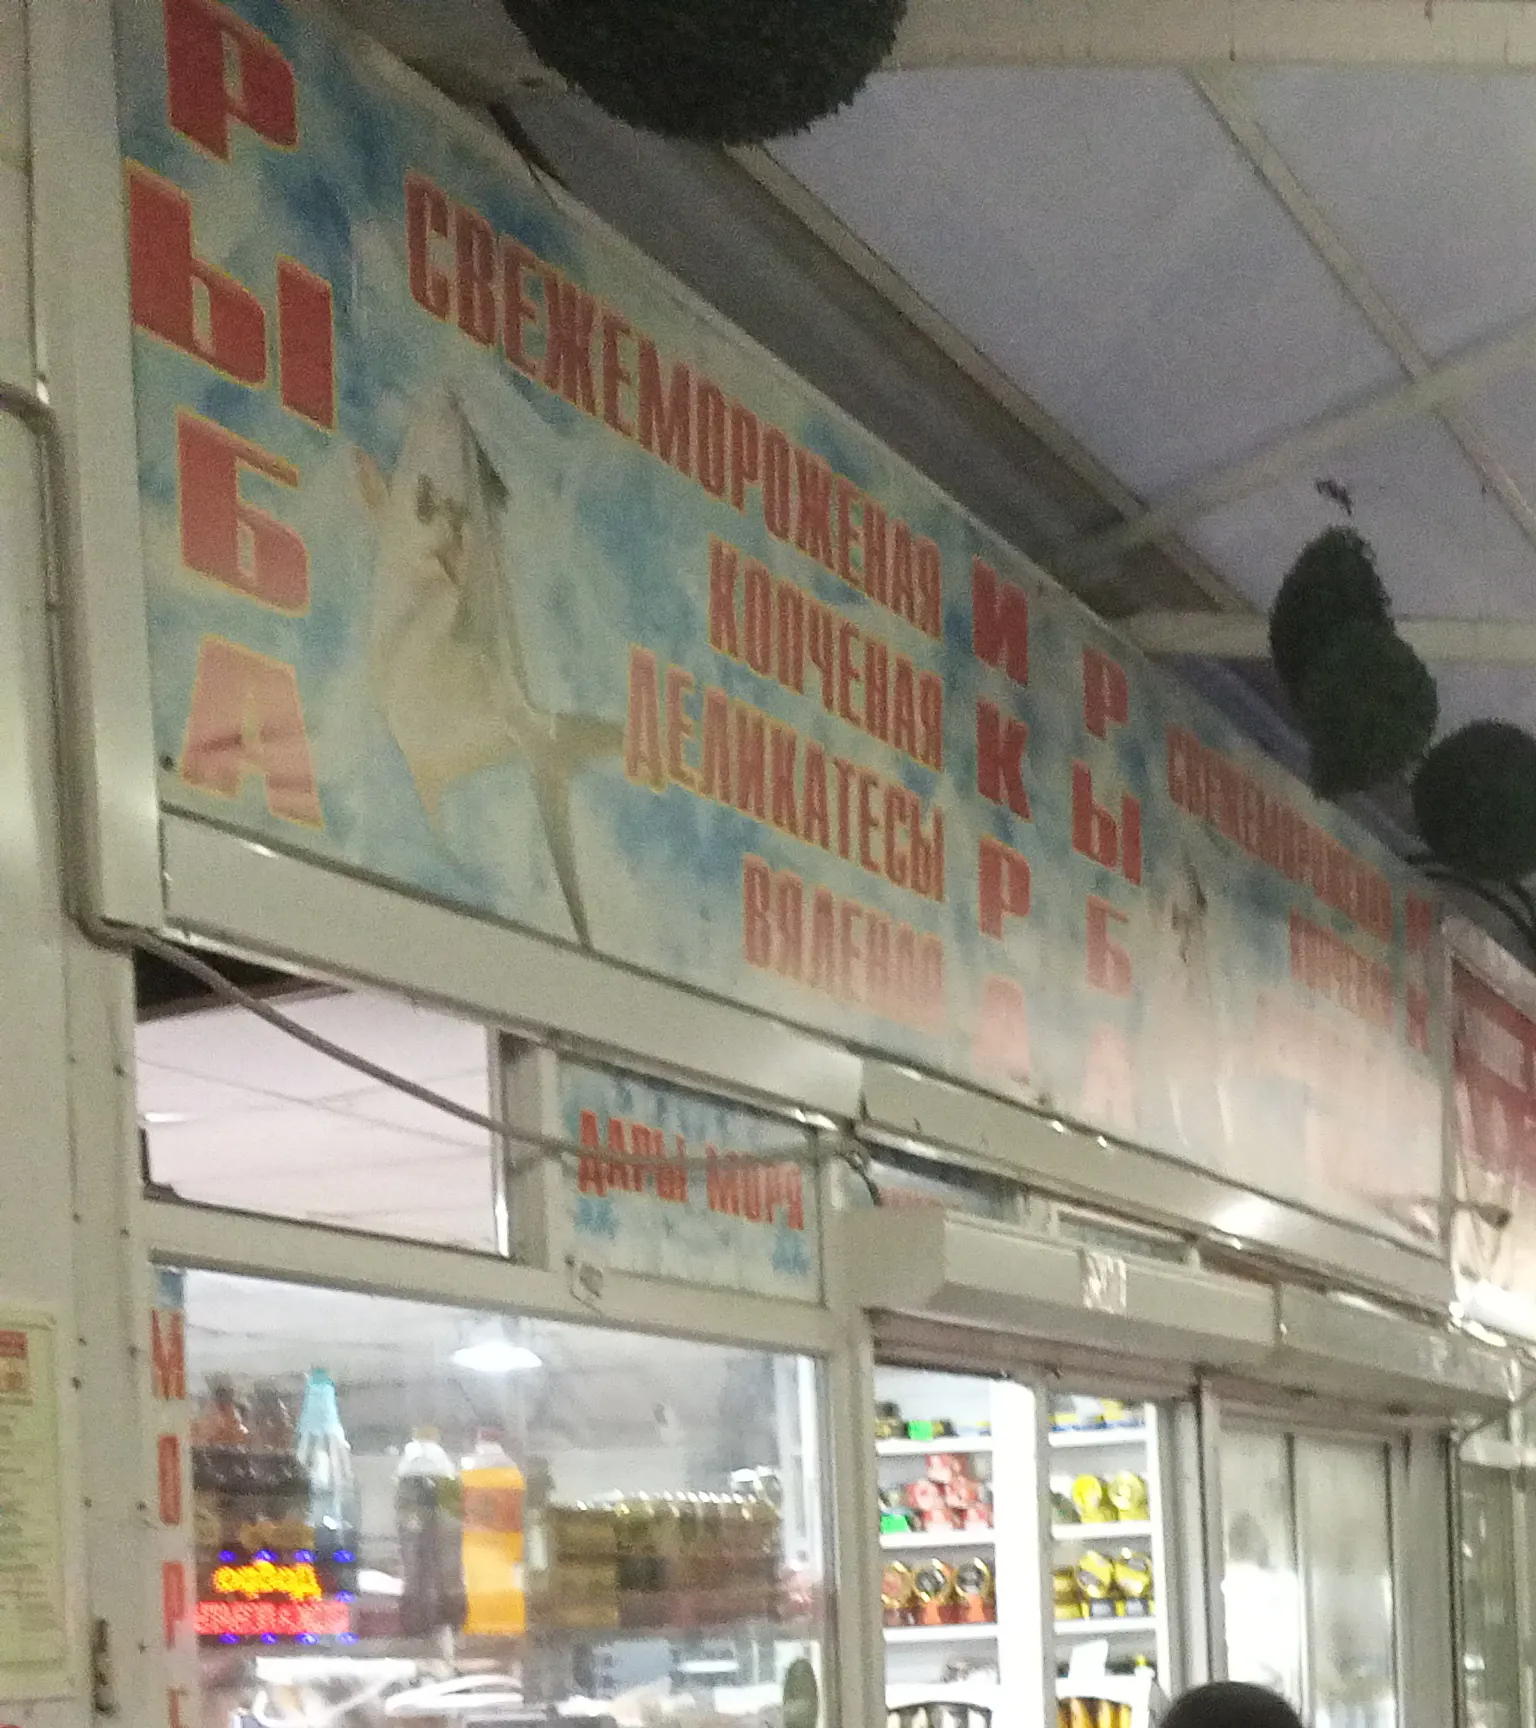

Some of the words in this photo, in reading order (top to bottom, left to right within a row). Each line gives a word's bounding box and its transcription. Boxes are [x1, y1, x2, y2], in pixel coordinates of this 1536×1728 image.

[127, 0, 335, 830] РЫБА
[405, 167, 943, 641] СВЕЖЕМОРОЖЕНАЯ
[625, 644, 944, 903] ДЕЛИКАТЕСЫ
[709, 534, 943, 773] КОПЧЕНАЯ
[972, 554, 1031, 1085] ИКРА
[1073, 645, 1141, 1130] РЫБА
